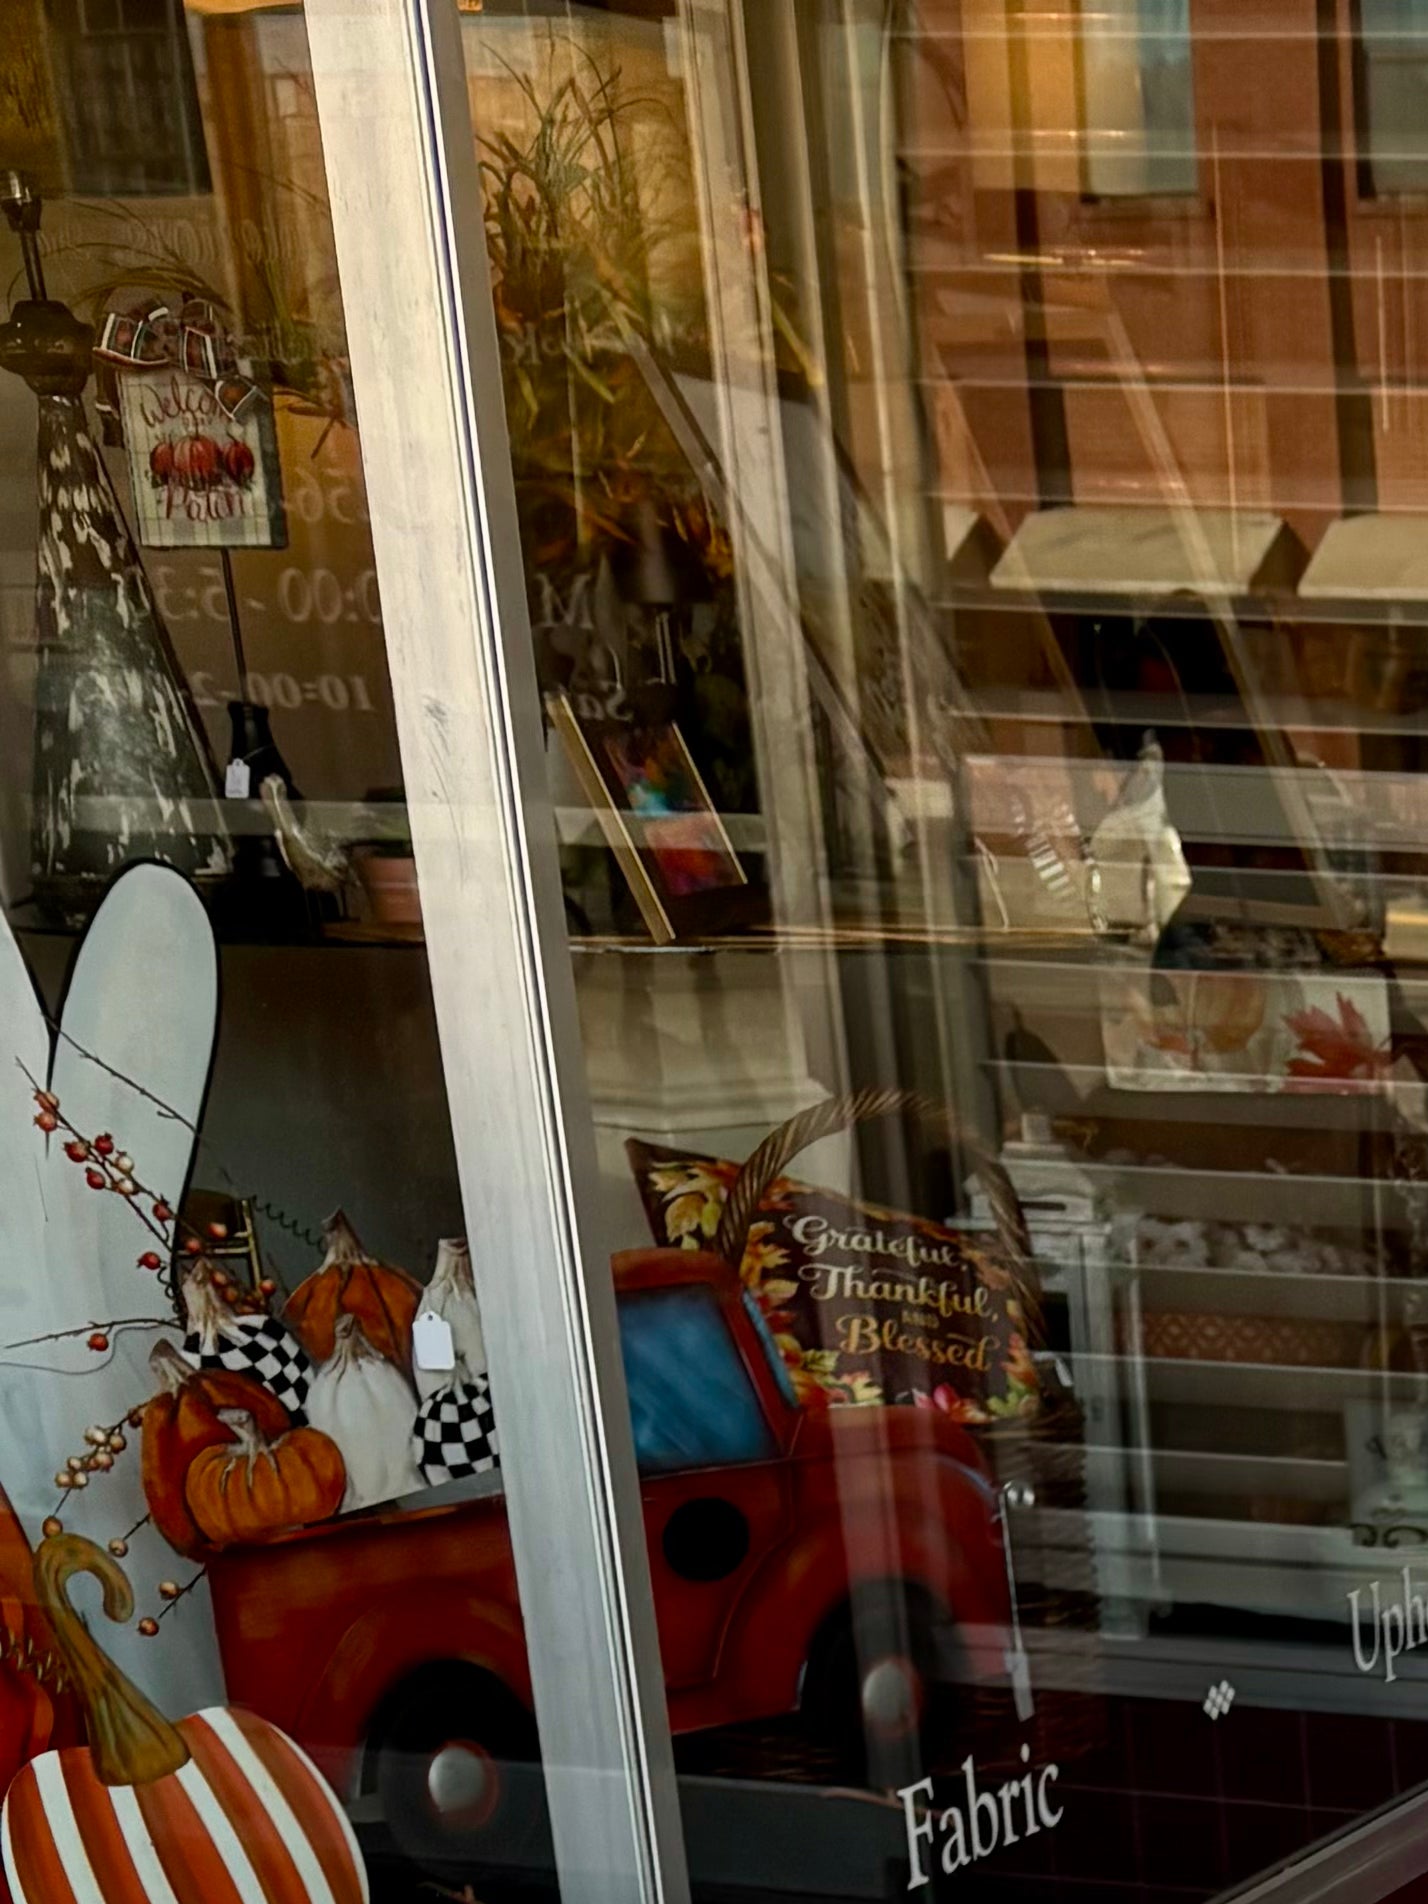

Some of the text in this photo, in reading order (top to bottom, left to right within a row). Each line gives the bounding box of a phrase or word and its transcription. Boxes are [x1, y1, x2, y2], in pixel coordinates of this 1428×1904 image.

[797, 1262, 999, 1323] Thankful,
[835, 1314, 1000, 1372] Blessed
[897, 1744, 1066, 1891] Fabric
